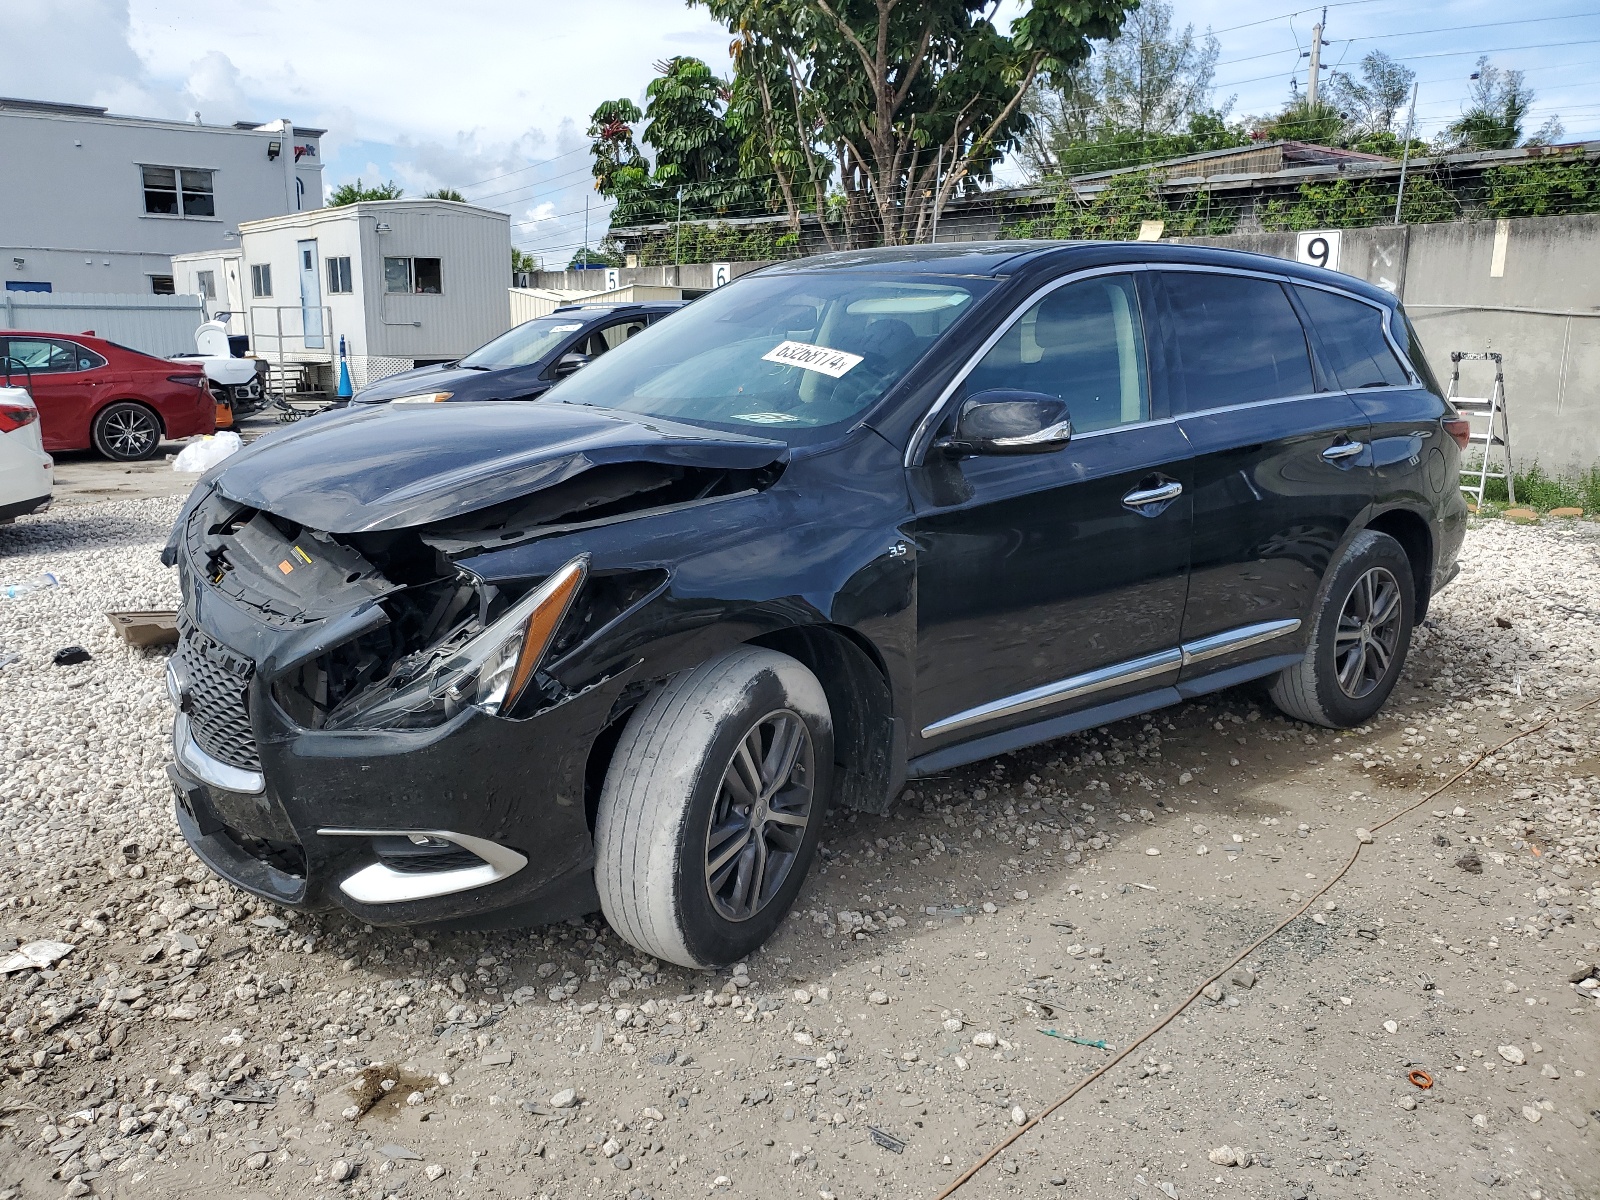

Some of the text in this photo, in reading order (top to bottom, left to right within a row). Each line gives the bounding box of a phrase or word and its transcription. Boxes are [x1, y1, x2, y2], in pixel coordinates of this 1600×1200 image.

[1307, 237, 1330, 268] 9
[608, 271, 616, 290] 5
[716, 267, 726, 287] 6
